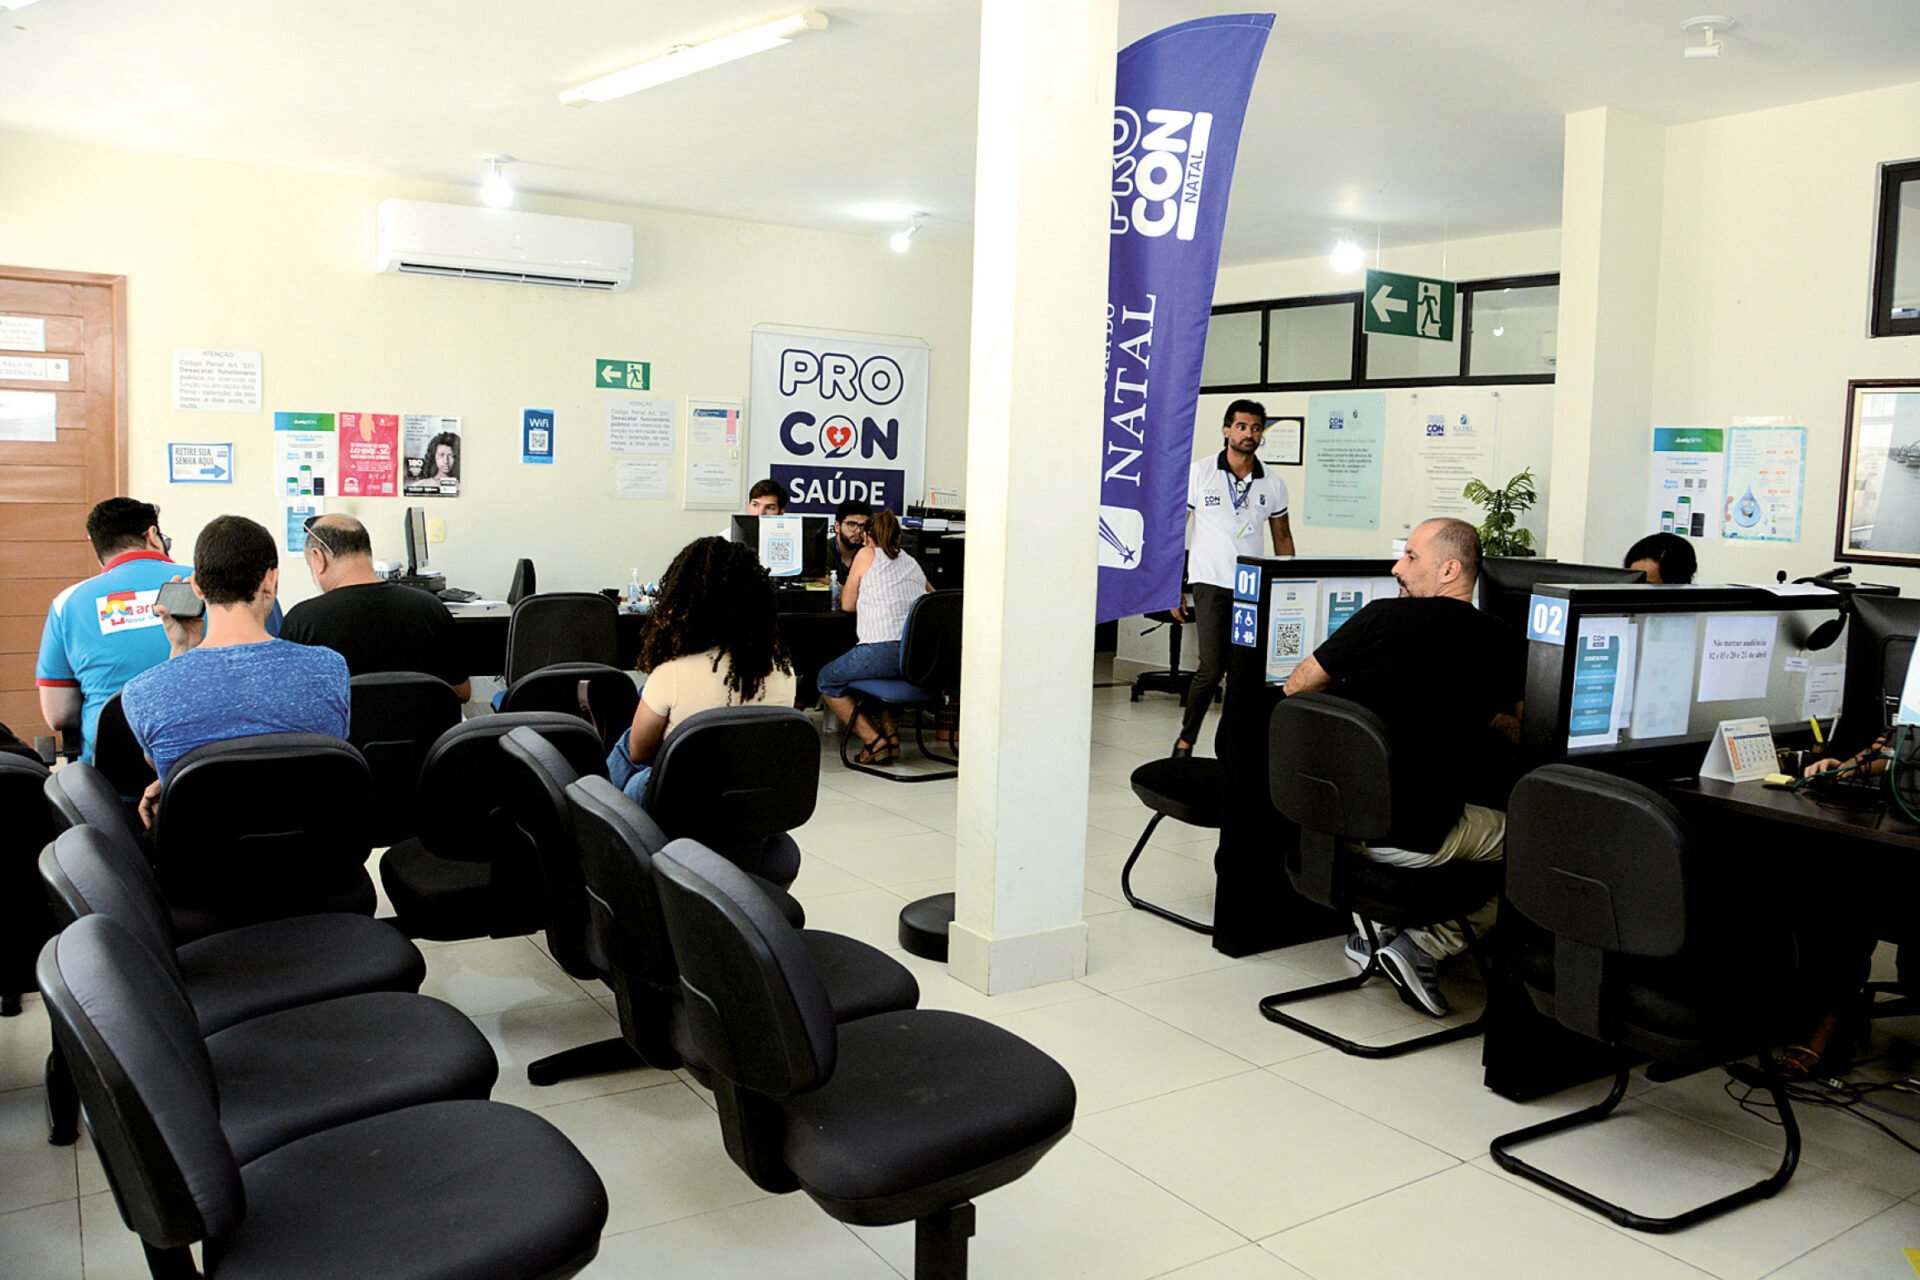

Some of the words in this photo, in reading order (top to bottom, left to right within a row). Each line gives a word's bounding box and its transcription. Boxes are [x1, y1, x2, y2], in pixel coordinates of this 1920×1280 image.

[1131, 108, 1193, 238] CON
[1184, 149, 1204, 203] NATAL
[779, 348, 904, 405] PRO
[1104, 293, 1157, 487] NATAL
[1328, 417, 1344, 425] CON
[1426, 424, 1444, 433] CON
[779, 411, 899, 461] CON
[175, 447, 196, 456] RETIRE
[198, 447, 212, 457] SUA
[175, 456, 197, 465] SENHA
[198, 457, 214, 467] AQUI
[408, 459, 424, 467] 180
[789, 471, 886, 506] SAÚDE
[1204, 495, 1221, 504] CON
[1238, 570, 1257, 595] 01
[1533, 602, 1562, 637] 02
[1713, 638, 1723, 648] Não
[1743, 637, 1768, 647] audiência
